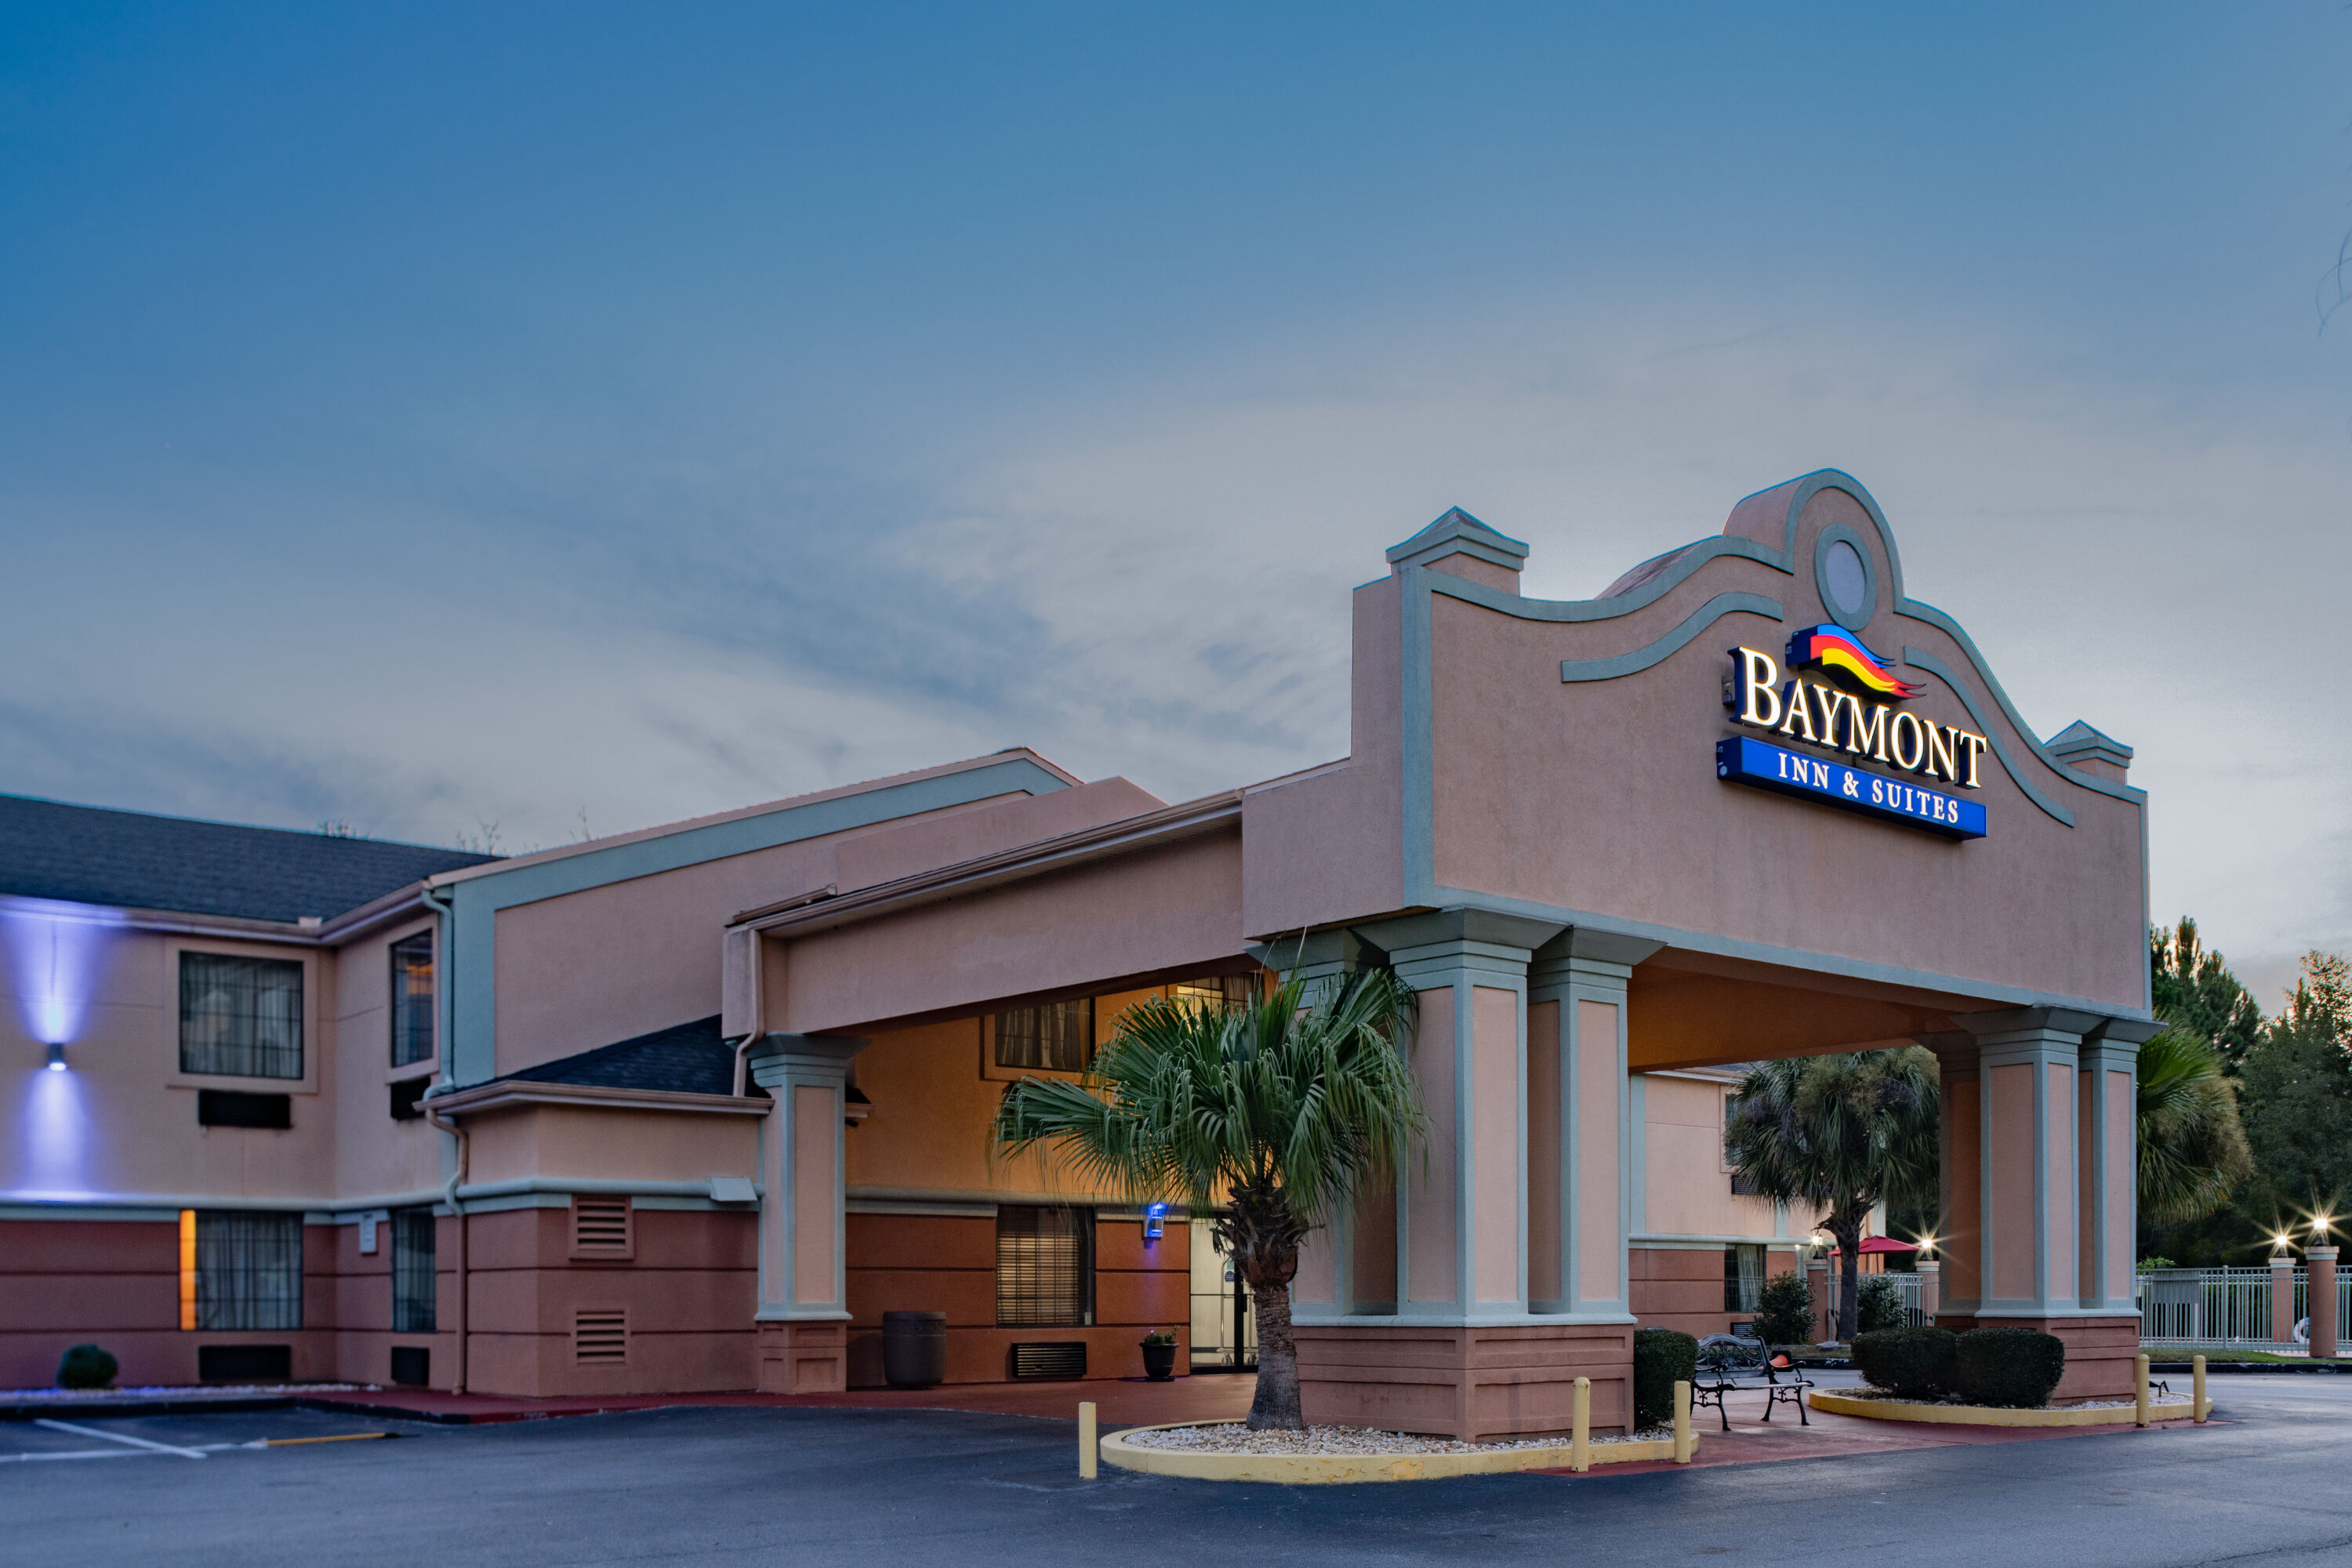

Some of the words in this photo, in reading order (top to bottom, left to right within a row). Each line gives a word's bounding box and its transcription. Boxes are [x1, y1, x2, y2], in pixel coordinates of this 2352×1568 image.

[1738, 646, 1987, 789] BAYMONT
[1777, 752, 1830, 789] INN
[1843, 771, 1859, 798] &
[1871, 779, 1958, 824] SUITES
